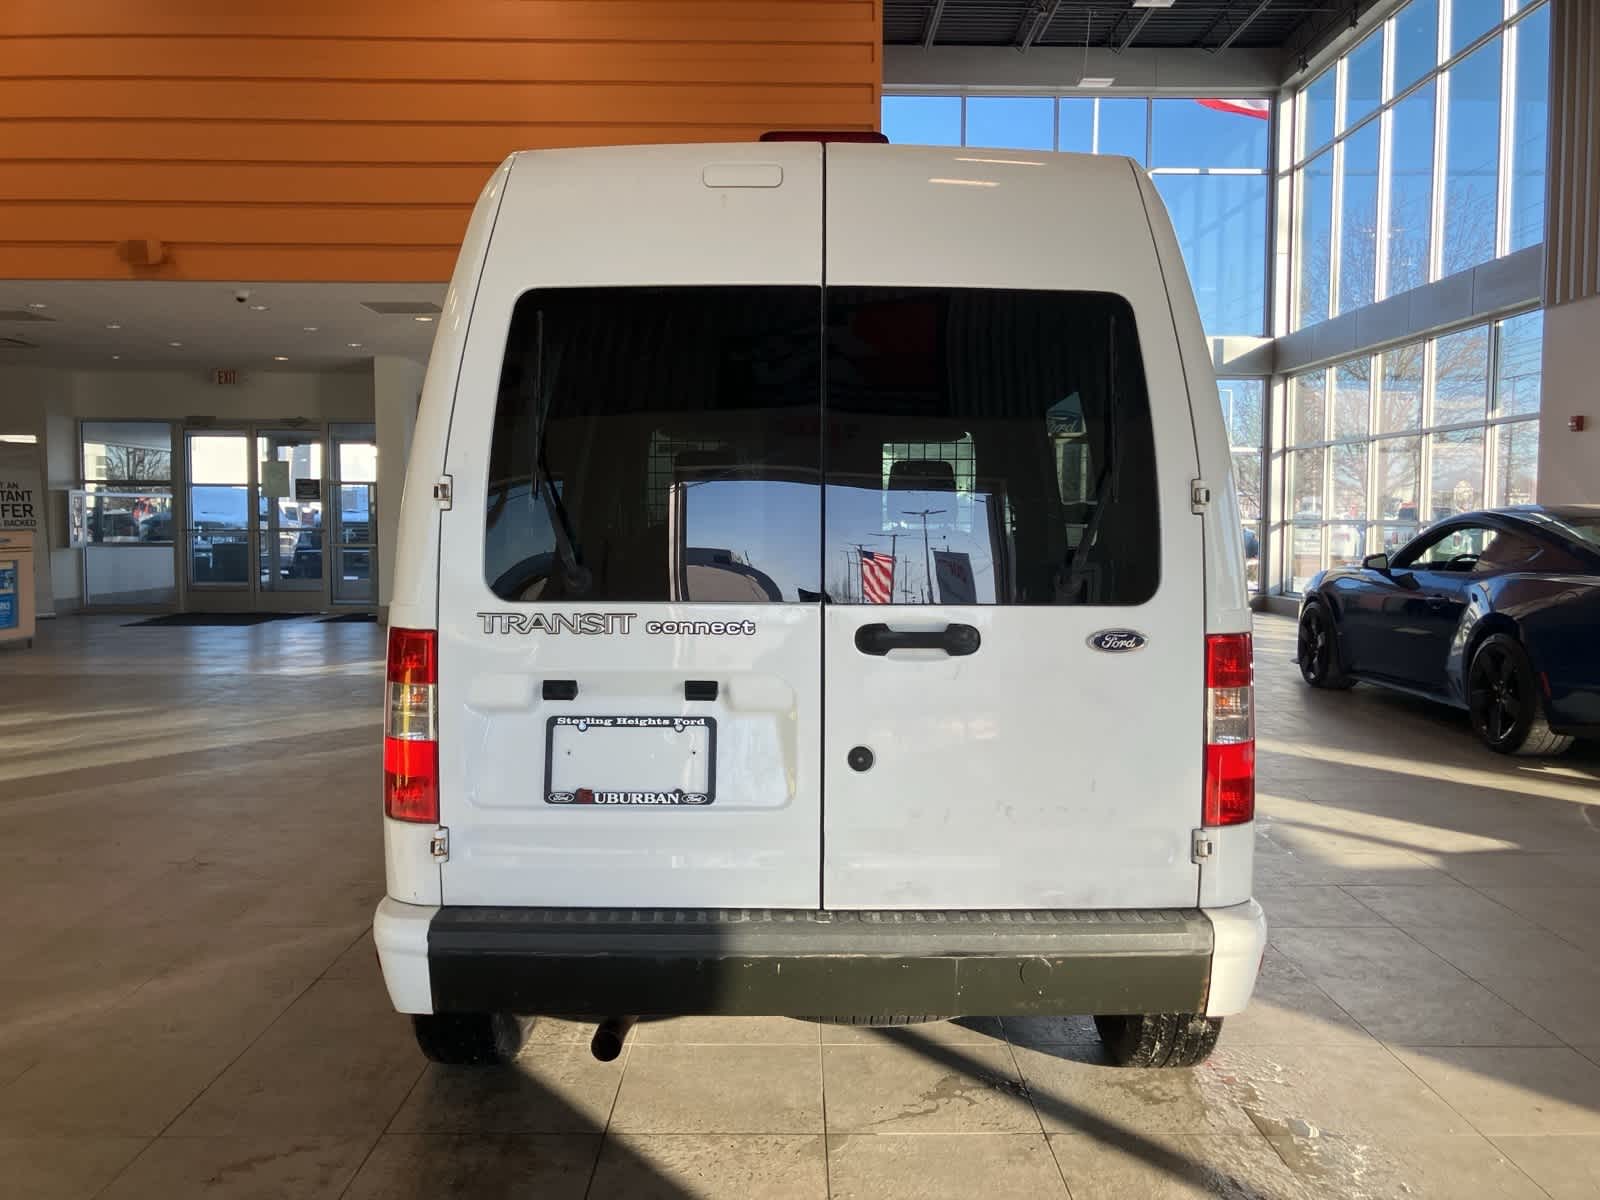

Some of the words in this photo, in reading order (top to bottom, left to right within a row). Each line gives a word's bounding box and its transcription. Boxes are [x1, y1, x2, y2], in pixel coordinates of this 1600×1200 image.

[217, 369, 237, 385] EXIT
[0, 490, 33, 502] TANT
[1, 503, 35, 518] FER
[477, 612, 638, 635] TRANSIT
[646, 619, 756, 636] connect
[1101, 632, 1137, 649] Ford
[556, 717, 613, 726] Sterling
[615, 717, 670, 726] Heights
[673, 717, 705, 726] Ford
